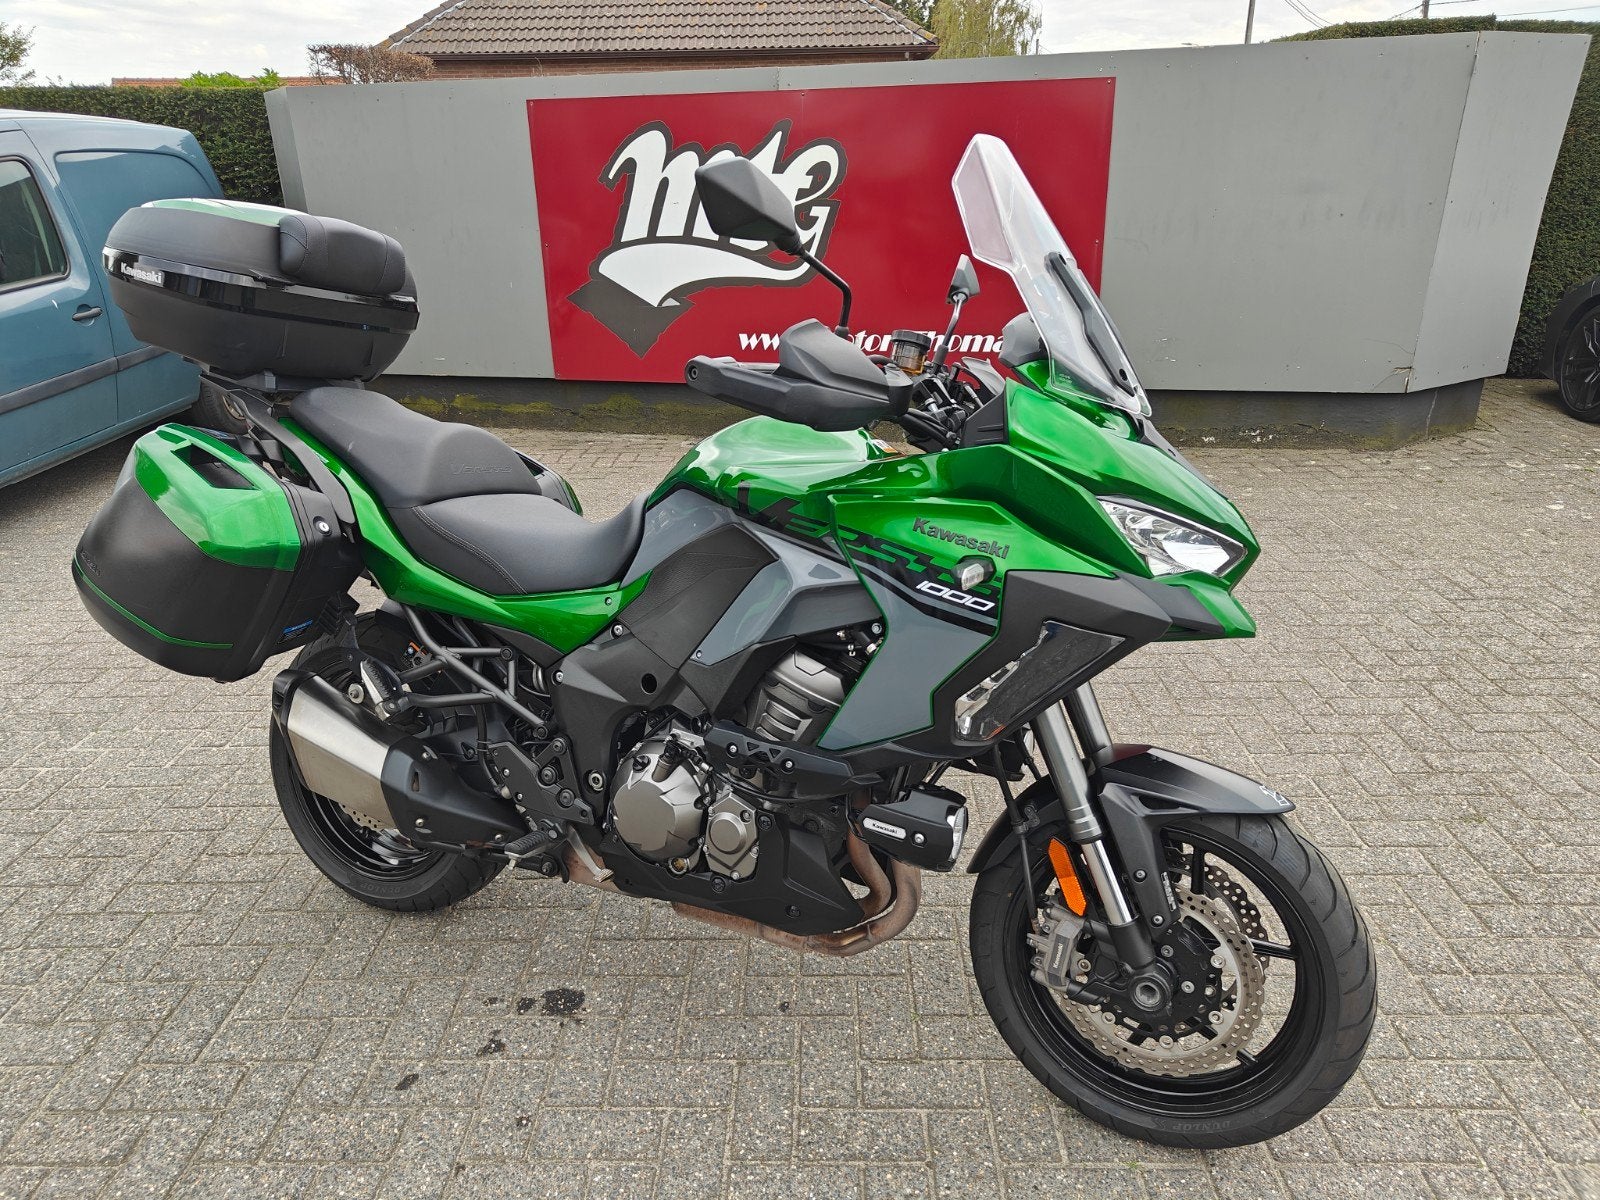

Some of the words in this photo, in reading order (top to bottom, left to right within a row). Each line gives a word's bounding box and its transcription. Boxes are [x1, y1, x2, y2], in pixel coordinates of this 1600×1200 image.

[120, 261, 163, 284] Kawasaki
[912, 516, 1010, 560] Kawasaki
[915, 580, 996, 612] 1000
[872, 821, 898, 835] Kawasaki
[1172, 1120, 1231, 1132] DUNLOP
